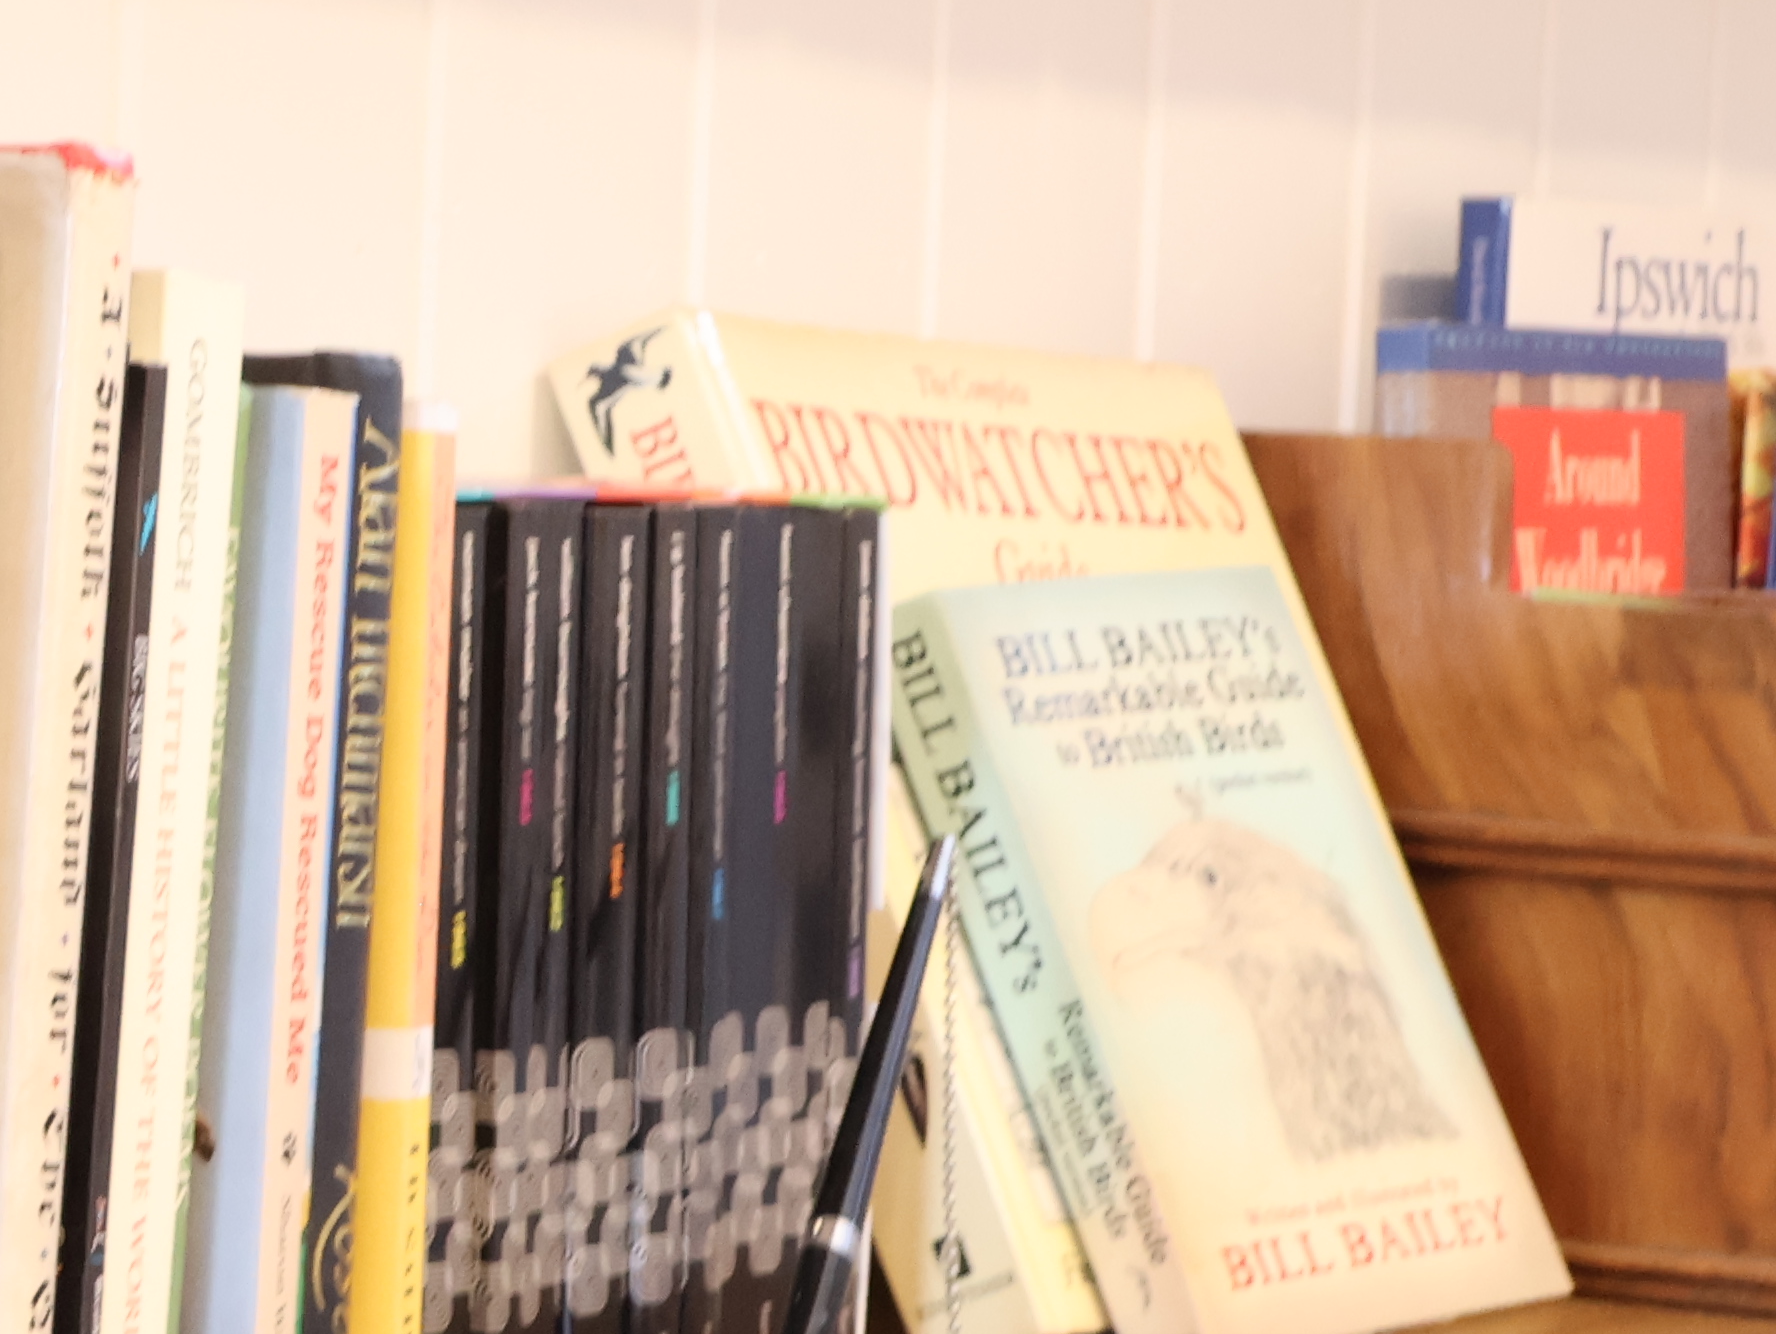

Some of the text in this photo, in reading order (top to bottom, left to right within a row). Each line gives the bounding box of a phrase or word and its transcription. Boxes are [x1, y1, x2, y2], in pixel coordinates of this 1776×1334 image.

[1596, 226, 1760, 331] Ipswich
[174, 337, 208, 593] GOMBRICH
[353, 414, 399, 594] Alan
[750, 397, 1247, 538] BIRDWATCHER'S
[1545, 427, 1642, 507] Around
[169, 615, 188, 646] A
[996, 626, 1099, 681] BILL
[158, 661, 186, 817] LITTLE
[891, 628, 951, 756] BILL
[1002, 665, 1306, 727] Remarkable Guide
[1082, 719, 1198, 768] British
[1200, 710, 1288, 757] Birds
[285, 453, 341, 1086] My Rescue Dog Rescued Me
[146, 828, 176, 1025] HISTORY
[140, 1035, 159, 1098] OF
[132, 1117, 155, 1202] THE
[1058, 997, 1138, 1171] Remarkable
[1123, 1163, 1172, 1267] Guide
[1219, 1193, 1509, 1293] BILL BAILEY
